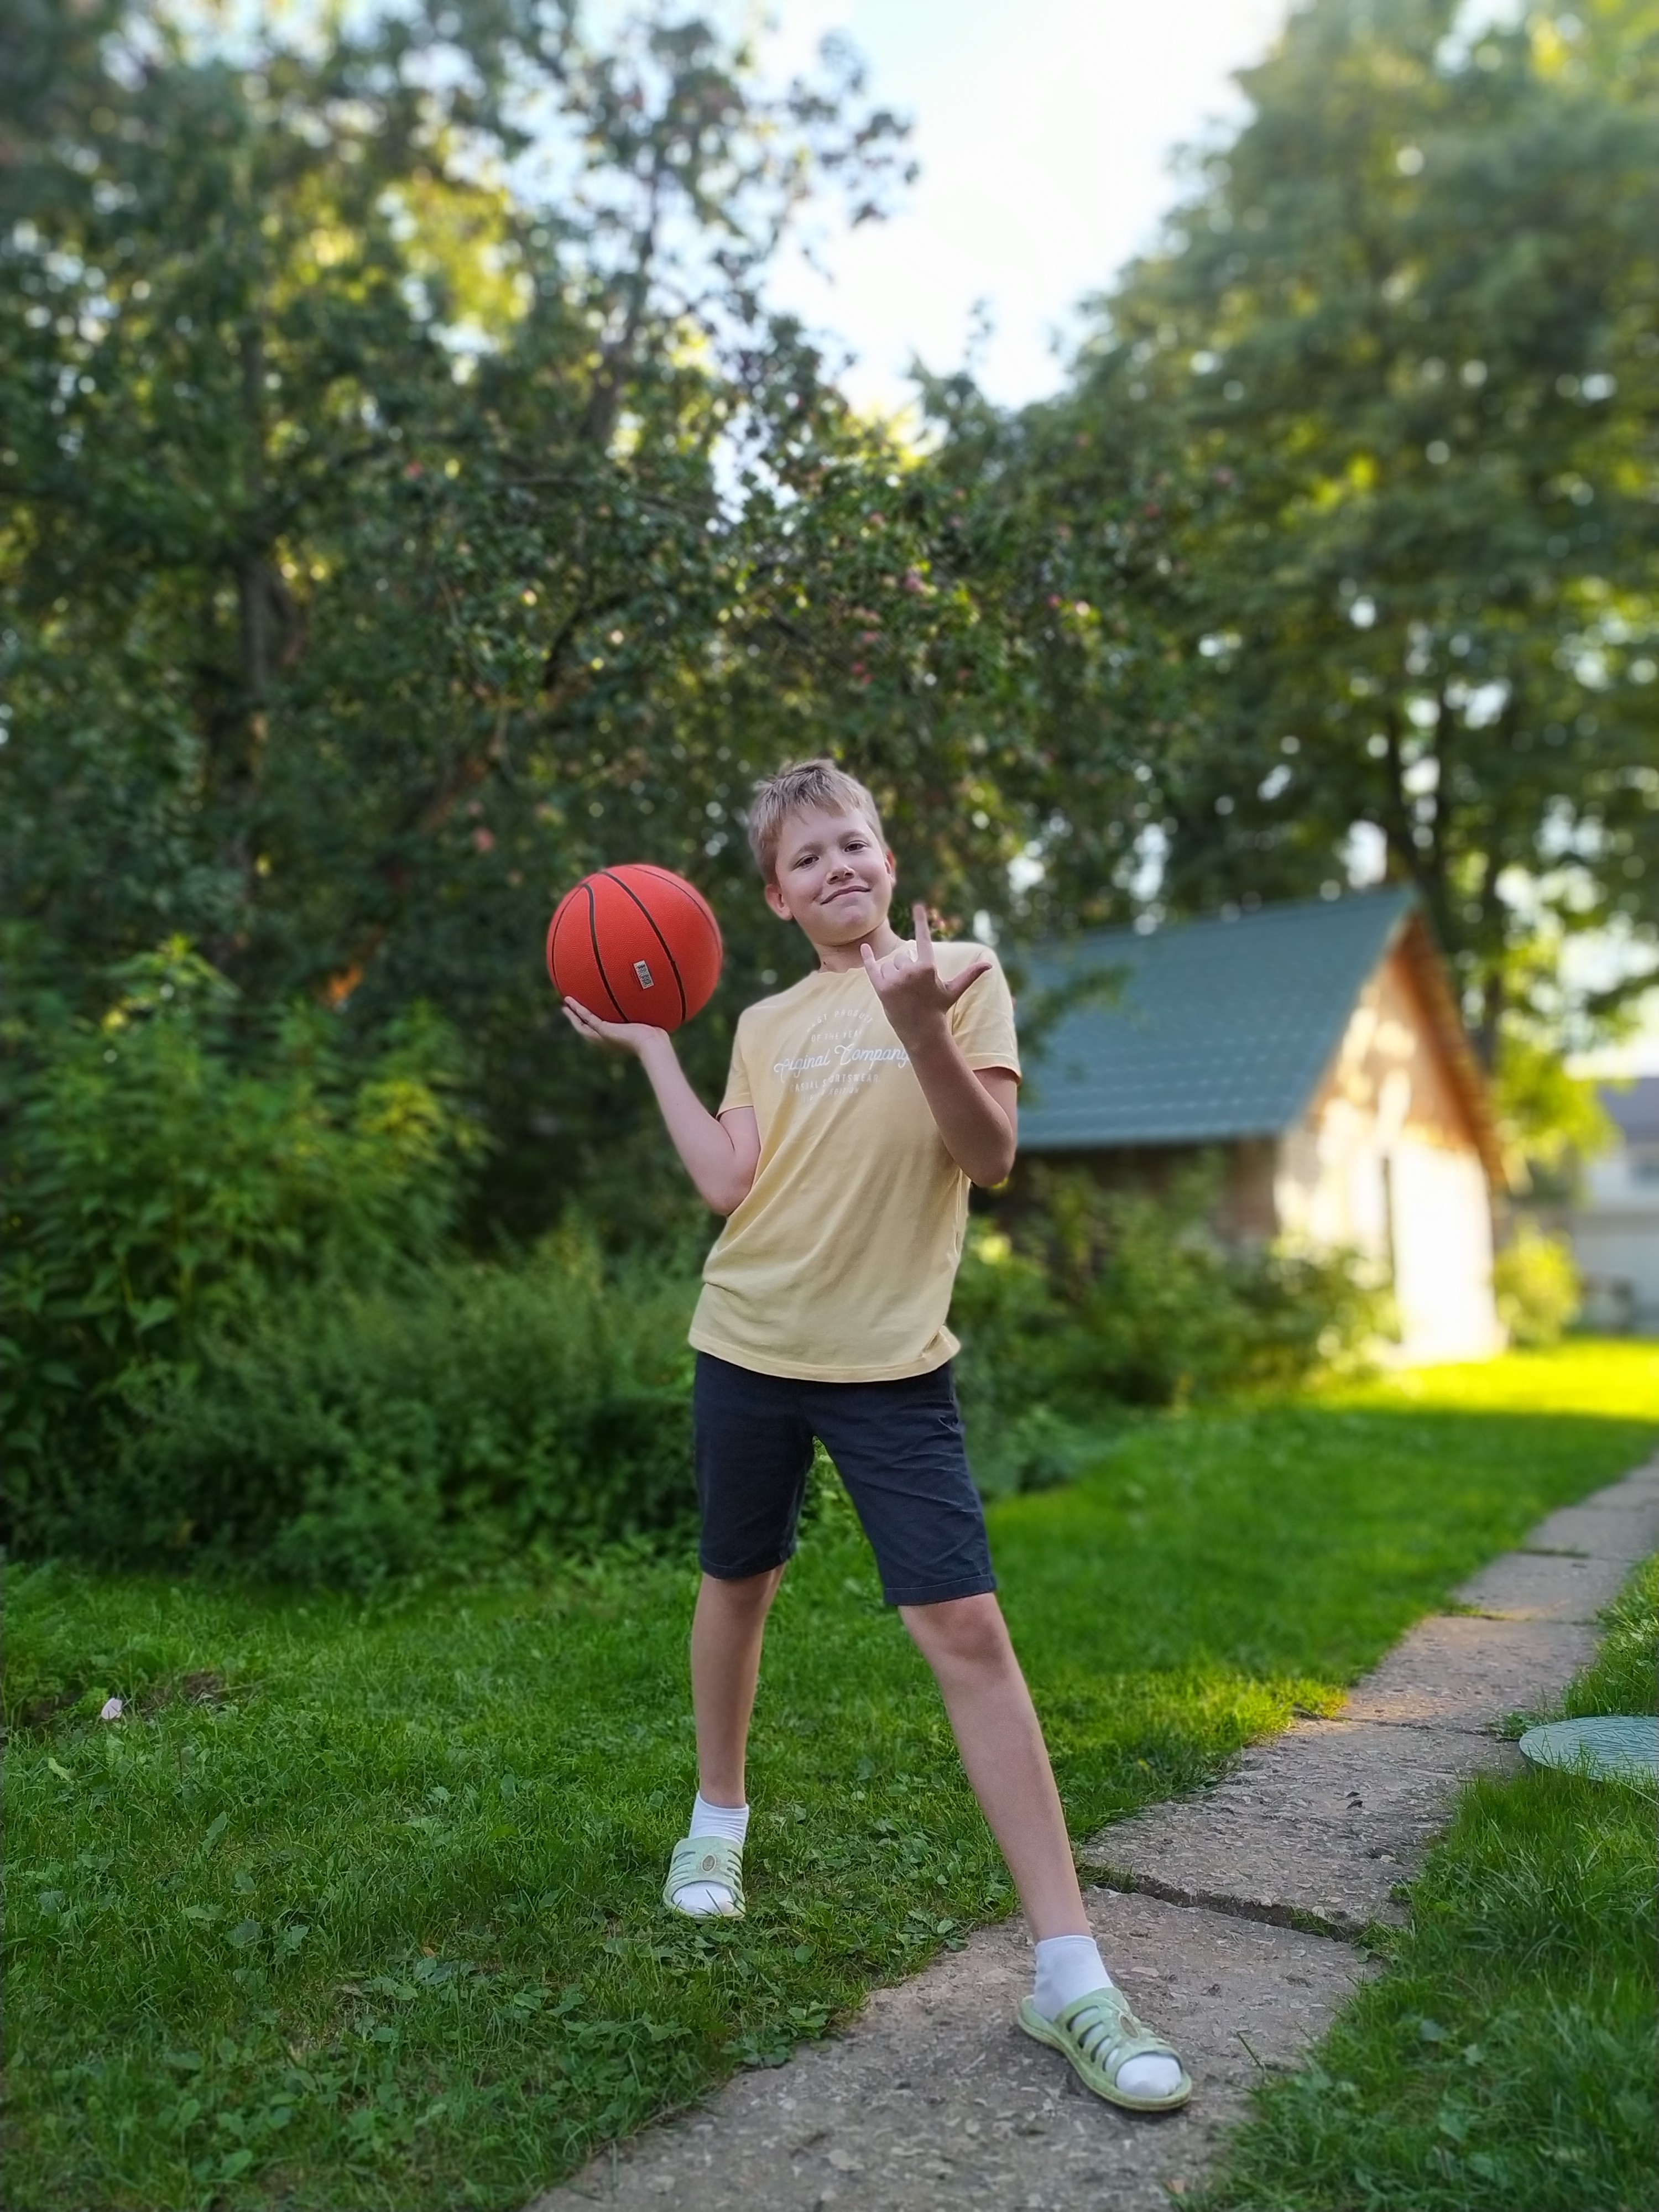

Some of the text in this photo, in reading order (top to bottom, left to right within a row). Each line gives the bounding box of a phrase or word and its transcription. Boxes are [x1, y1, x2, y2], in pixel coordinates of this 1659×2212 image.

[774, 1044, 909, 1083] Original Company
[823, 1074, 878, 1087] SORTSWEAR
